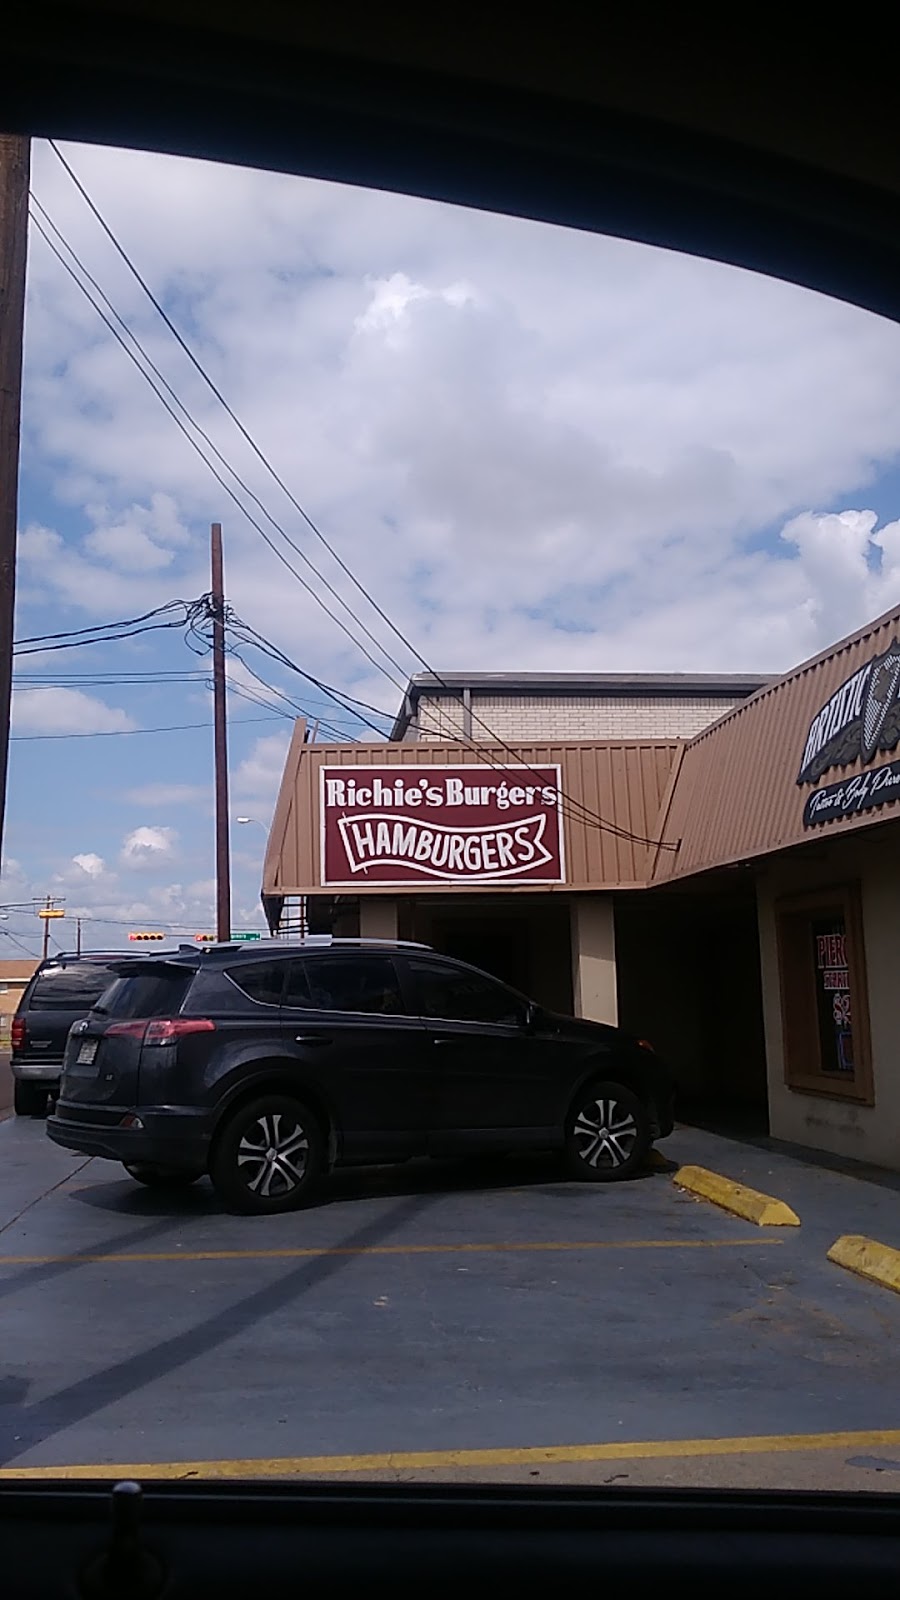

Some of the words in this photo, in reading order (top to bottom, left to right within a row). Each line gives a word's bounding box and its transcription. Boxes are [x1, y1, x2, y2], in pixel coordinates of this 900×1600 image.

[326, 779, 444, 807] Richie's
[445, 778, 557, 809] Burgers
[352, 822, 535, 870] HAMBURGERS
